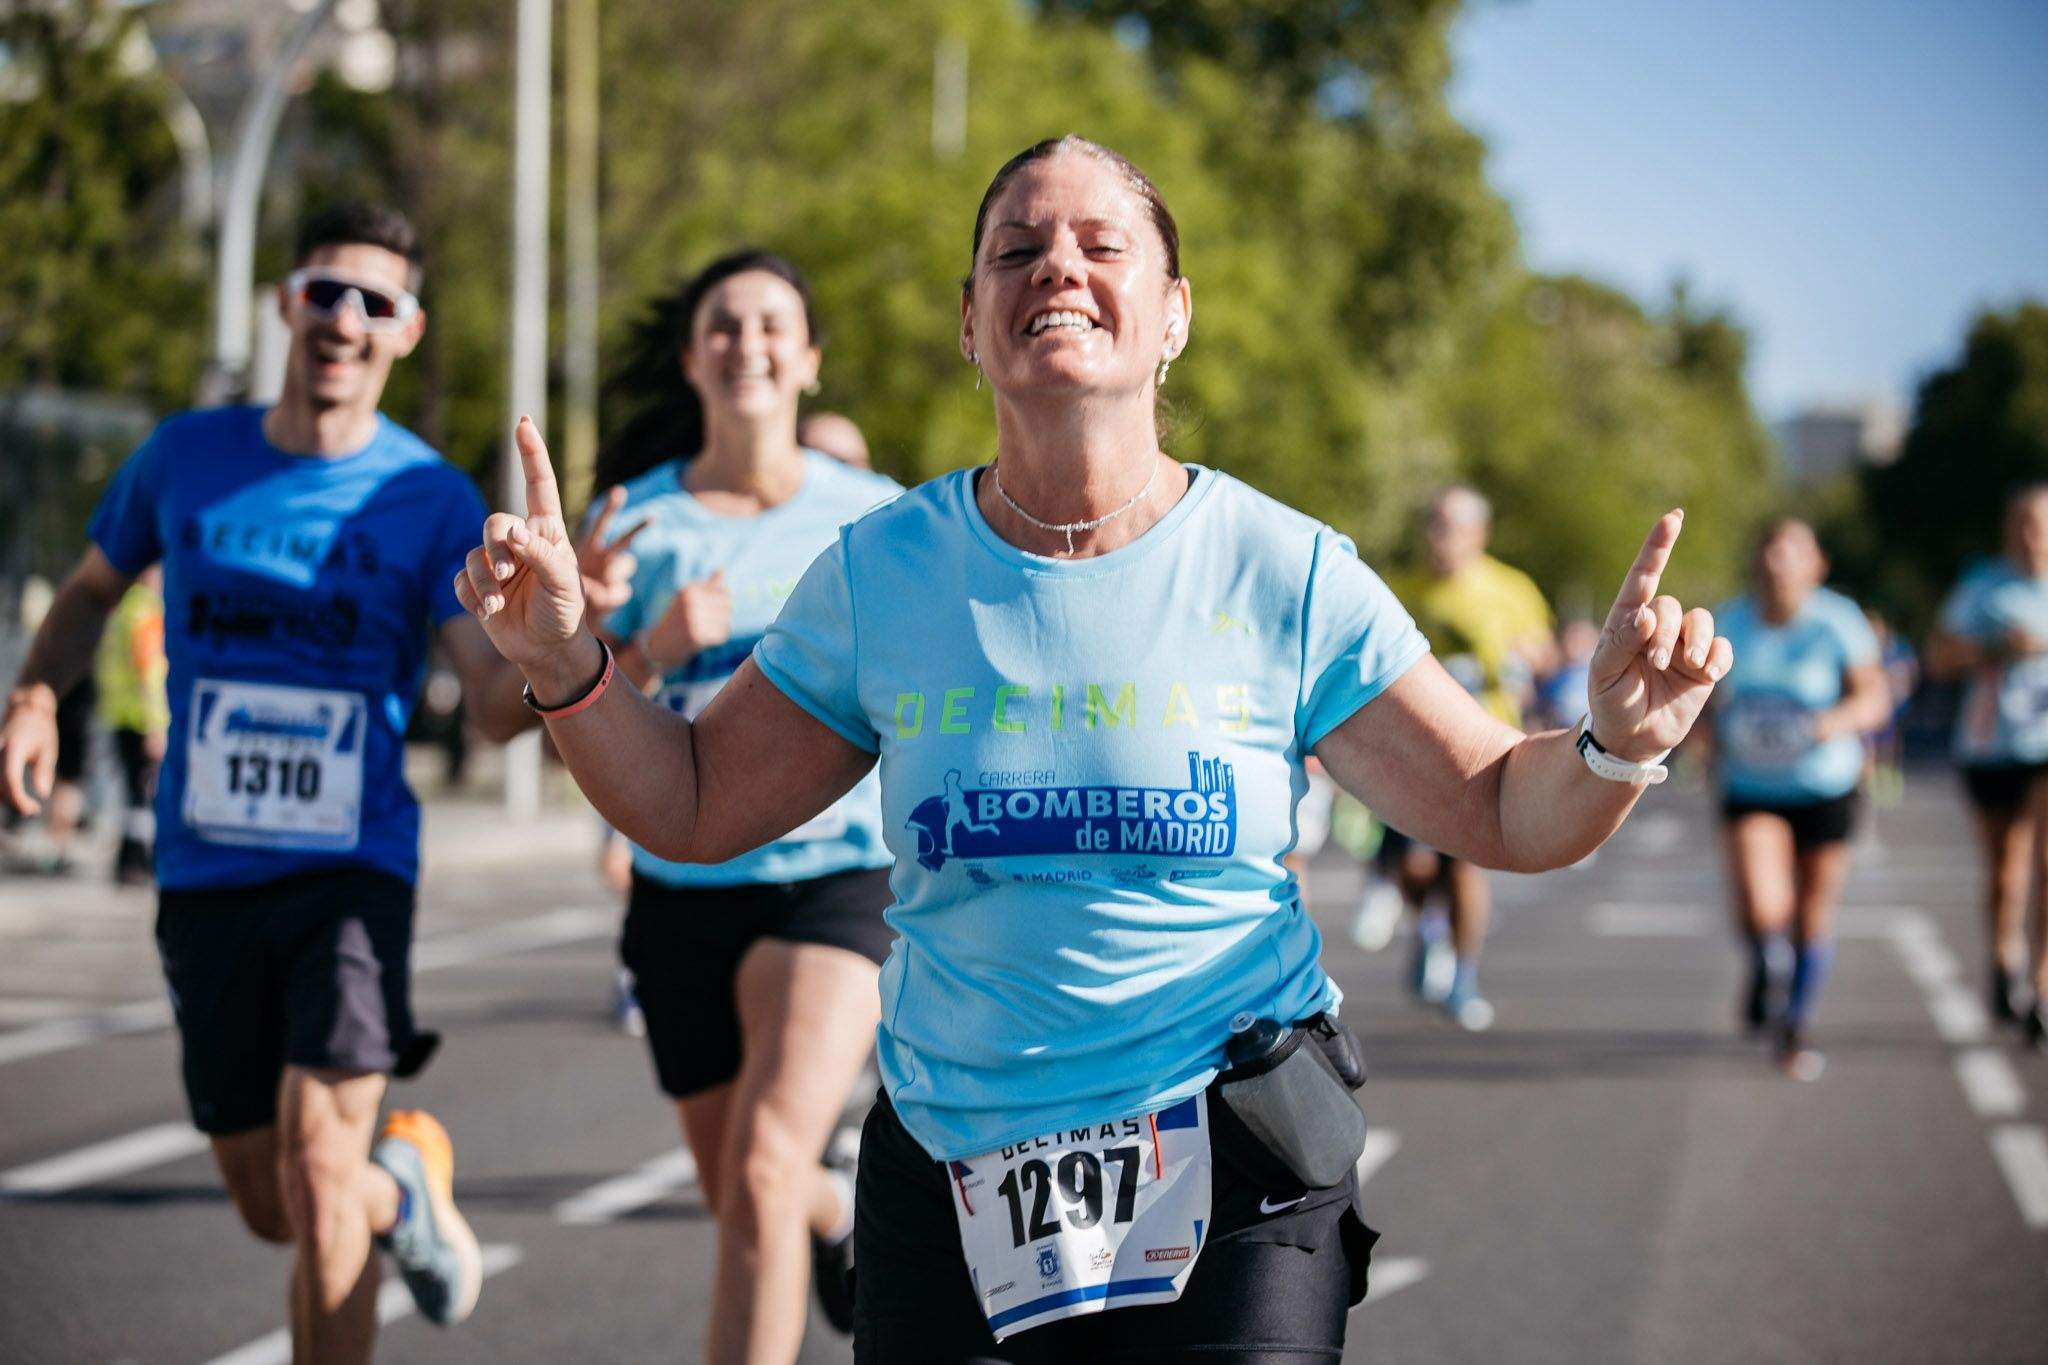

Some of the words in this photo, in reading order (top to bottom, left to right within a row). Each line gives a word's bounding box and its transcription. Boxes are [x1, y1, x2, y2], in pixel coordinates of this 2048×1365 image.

[895, 682, 1250, 739] DECIMAS
[227, 755, 322, 801] 1310
[978, 769, 1056, 787] CARRERA
[978, 789, 1229, 822] BOMBEROS
[1075, 821, 1110, 852] de
[1120, 821, 1230, 854] MADRID
[1031, 869, 1092, 883] MADRID
[997, 1145, 1140, 1249] 1297
